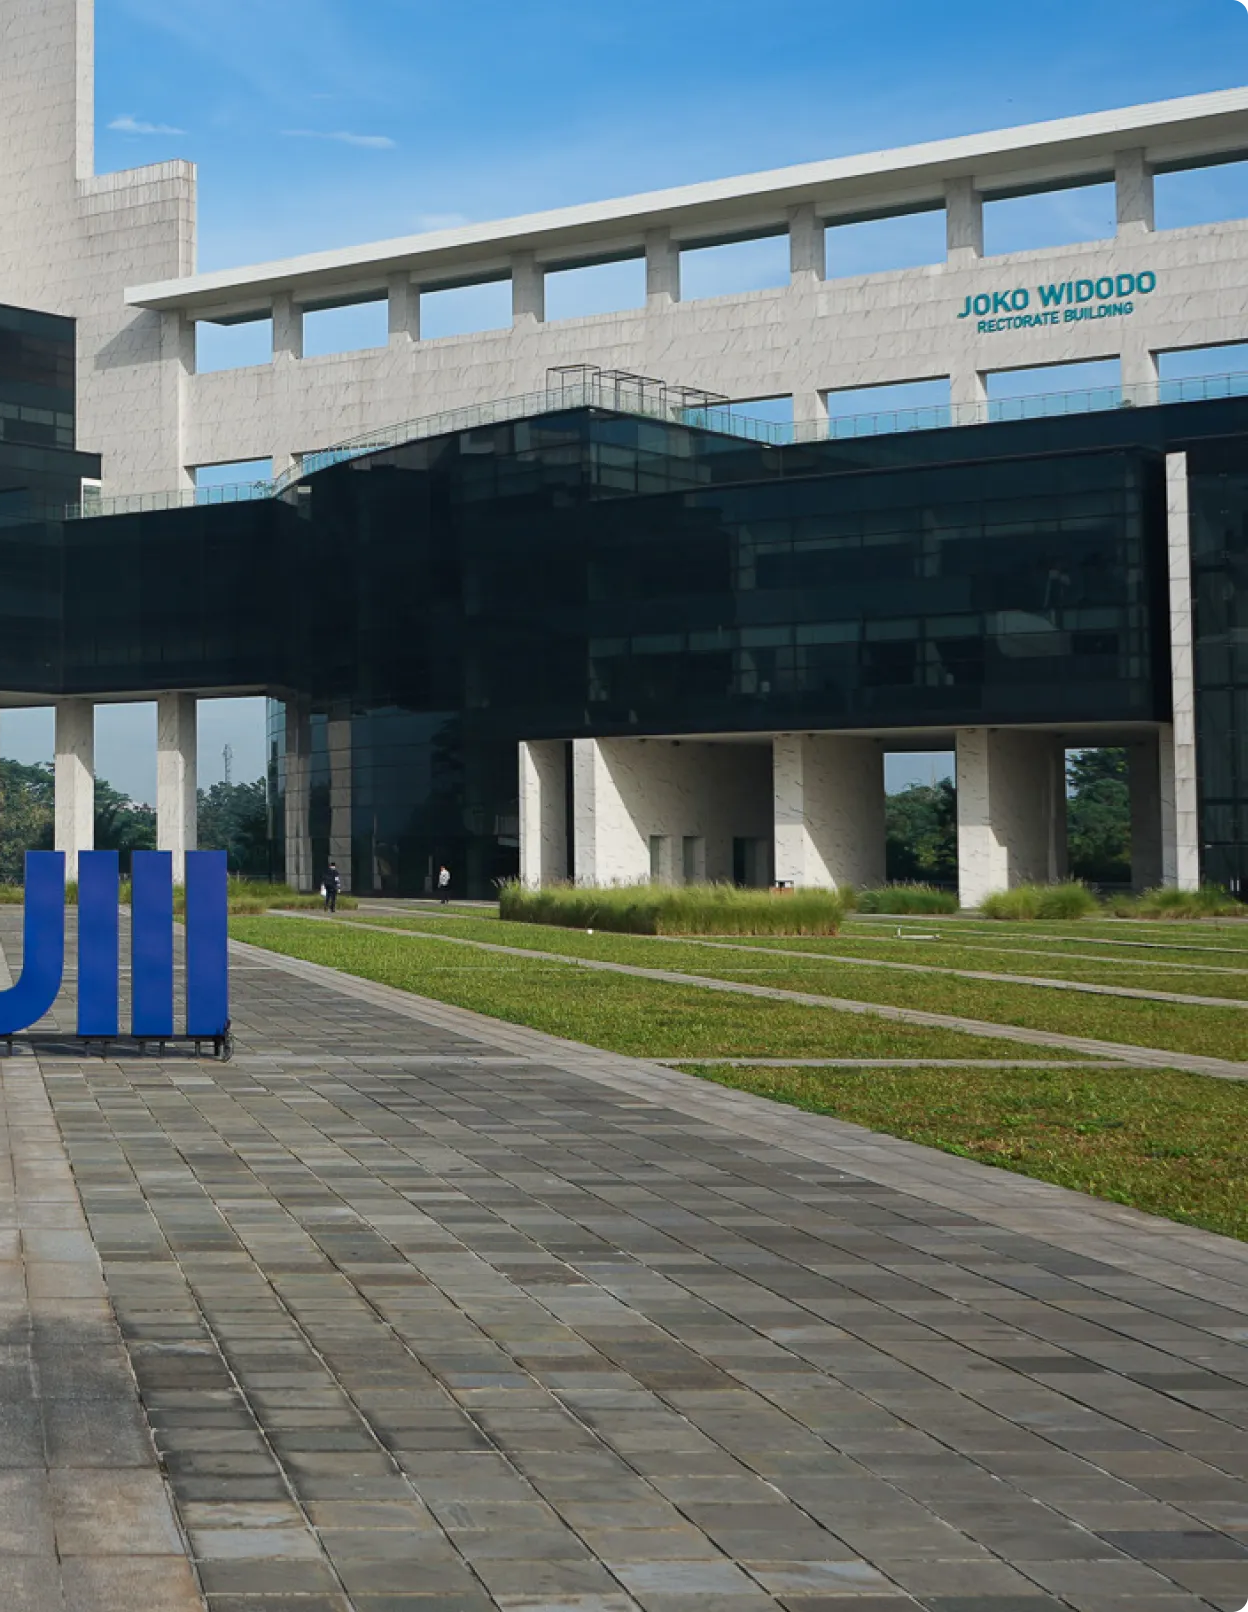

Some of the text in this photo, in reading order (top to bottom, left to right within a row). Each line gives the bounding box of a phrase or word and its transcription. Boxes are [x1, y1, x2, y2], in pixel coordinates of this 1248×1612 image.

[958, 271, 1156, 318] JOKO WIDODO
[978, 302, 1134, 333] RECTORATE BUILDING
